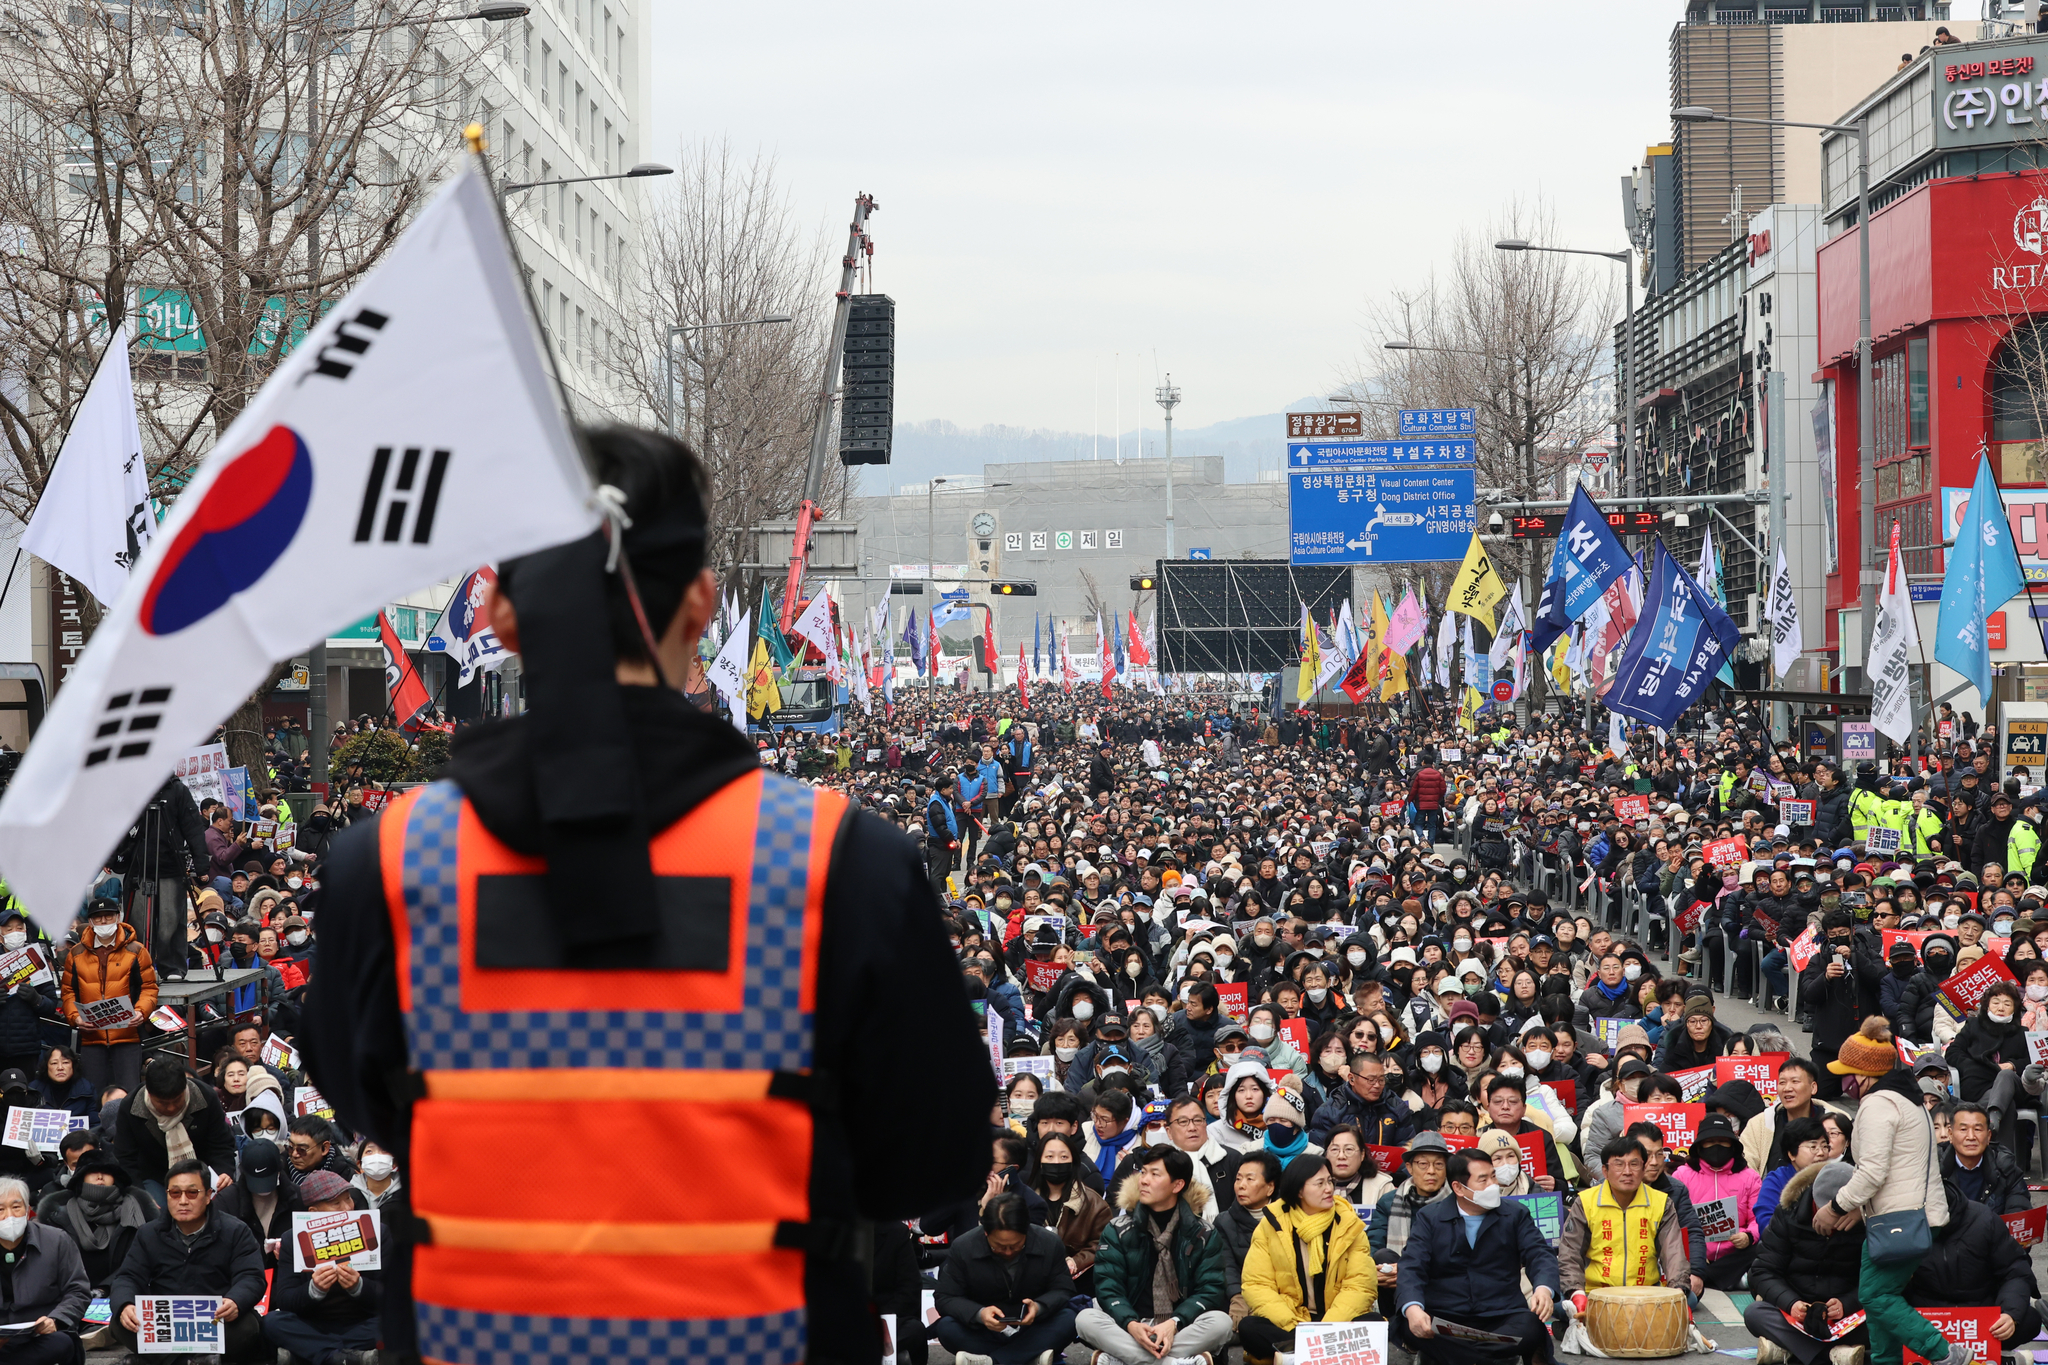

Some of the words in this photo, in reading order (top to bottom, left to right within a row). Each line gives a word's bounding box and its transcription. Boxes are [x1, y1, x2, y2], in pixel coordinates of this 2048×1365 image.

[1944, 62, 1984, 82] 통신의
[146, 301, 198, 340] 하나
[1292, 415, 1337, 426] 정율성가
[1403, 412, 1472, 424] 문화전당역
[1429, 424, 1457, 432] Complex
[1317, 446, 1388, 458] 국립아시아문화전당
[1392, 445, 1466, 460] 부설주차장
[1302, 474, 1376, 490] 영상복합문화관
[1381, 479, 1400, 488] Visual
[1404, 478, 1429, 487] Content
[1432, 477, 1454, 486] Center
[1337, 489, 1377, 503] 동구청
[1382, 492, 1400, 503] Dong
[1404, 492, 1429, 501] District
[1432, 491, 1456, 500] Office
[1426, 504, 1474, 519] 사직공원
[1426, 520, 1474, 534] GFN영어방송
[1007, 532, 1046, 549] 안전
[1082, 531, 1121, 548] 제일
[1293, 532, 1344, 545] 국립아시아문화전당
[1360, 532, 1378, 541] 50m
[1294, 546, 1305, 555] Asia
[1306, 546, 1326, 555] Culture
[1327, 545, 1345, 554] Center
[1074, 657, 1098, 668] 복원하
[1850, 722, 1867, 731] 택시
[2018, 724, 2039, 732] 택시
[1882, 829, 1899, 841] 즉각
[1712, 842, 1735, 856] 윤석열
[1881, 840, 1898, 850] 파면
[1709, 855, 1725, 866] 즉각
[1725, 851, 1742, 862] 파면
[1037, 967, 1063, 978] 윤석열
[1034, 975, 1050, 987] 즉각
[1953, 964, 1997, 997] 김건희도
[1220, 992, 1242, 1002] 모이자
[1734, 1064, 1770, 1079] 윤석열
[1755, 1080, 1777, 1094] 파면
[305, 1100, 331, 1115] 윤석
[1154, 1104, 1167, 1114] 파
[1285, 1092, 1304, 1112] 파면
[8, 1110, 22, 1140] 내란수괴
[18, 1111, 33, 1141] 윤석열
[34, 1112, 66, 1127] 즉각
[69, 1119, 84, 1132] 각
[1644, 1112, 1686, 1132] 윤석열
[32, 1128, 63, 1143] 파면
[1242, 1122, 1263, 1140] 파면
[1666, 1130, 1695, 1147] 파면
[1697, 1200, 1723, 1216] 사자
[1698, 1210, 1727, 1227] 세력
[1602, 1220, 1612, 1240] 헌재
[1640, 1218, 1648, 1239] 내란
[1702, 1217, 1735, 1237] 하라
[311, 1222, 360, 1250] 윤석열
[315, 1238, 364, 1260] 즉각파면
[1602, 1246, 1613, 1278] 윤석열
[1636, 1245, 1648, 1286] 우두머리
[172, 1300, 217, 1320] 즉각
[142, 1300, 155, 1343] 내란수괴
[155, 1300, 172, 1342] 윤석열
[174, 1322, 218, 1342] 파면
[1306, 1335, 1324, 1359] 내란
[1325, 1338, 1372, 1356] 동조세력
